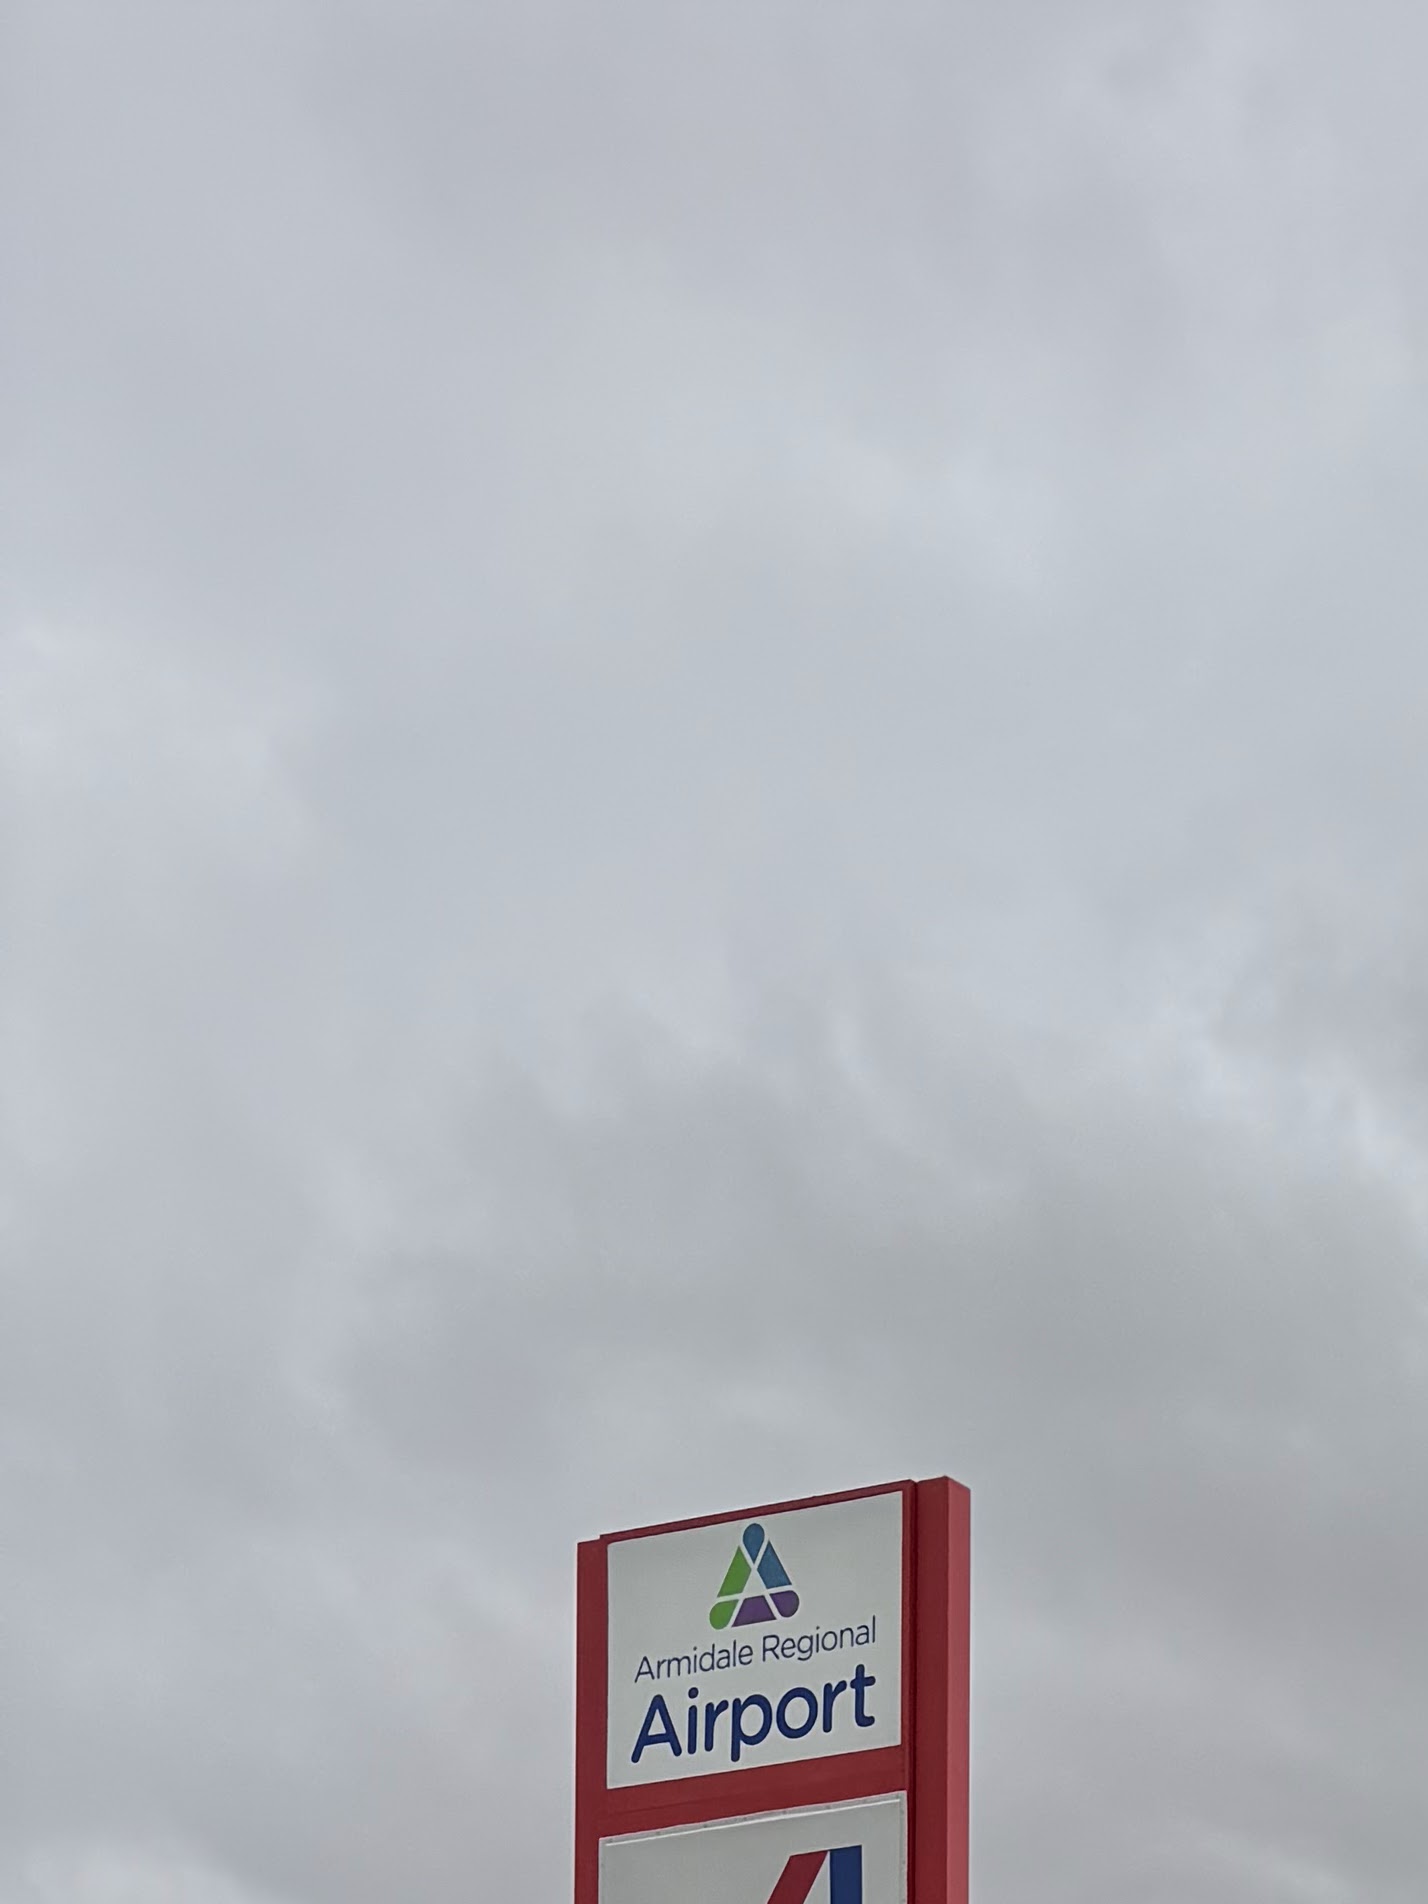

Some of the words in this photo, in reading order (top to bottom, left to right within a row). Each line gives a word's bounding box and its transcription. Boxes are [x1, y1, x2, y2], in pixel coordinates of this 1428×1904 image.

[634, 1640, 753, 1683] Armidale
[762, 1615, 876, 1662] Regional
[631, 1664, 876, 1763] Airport
